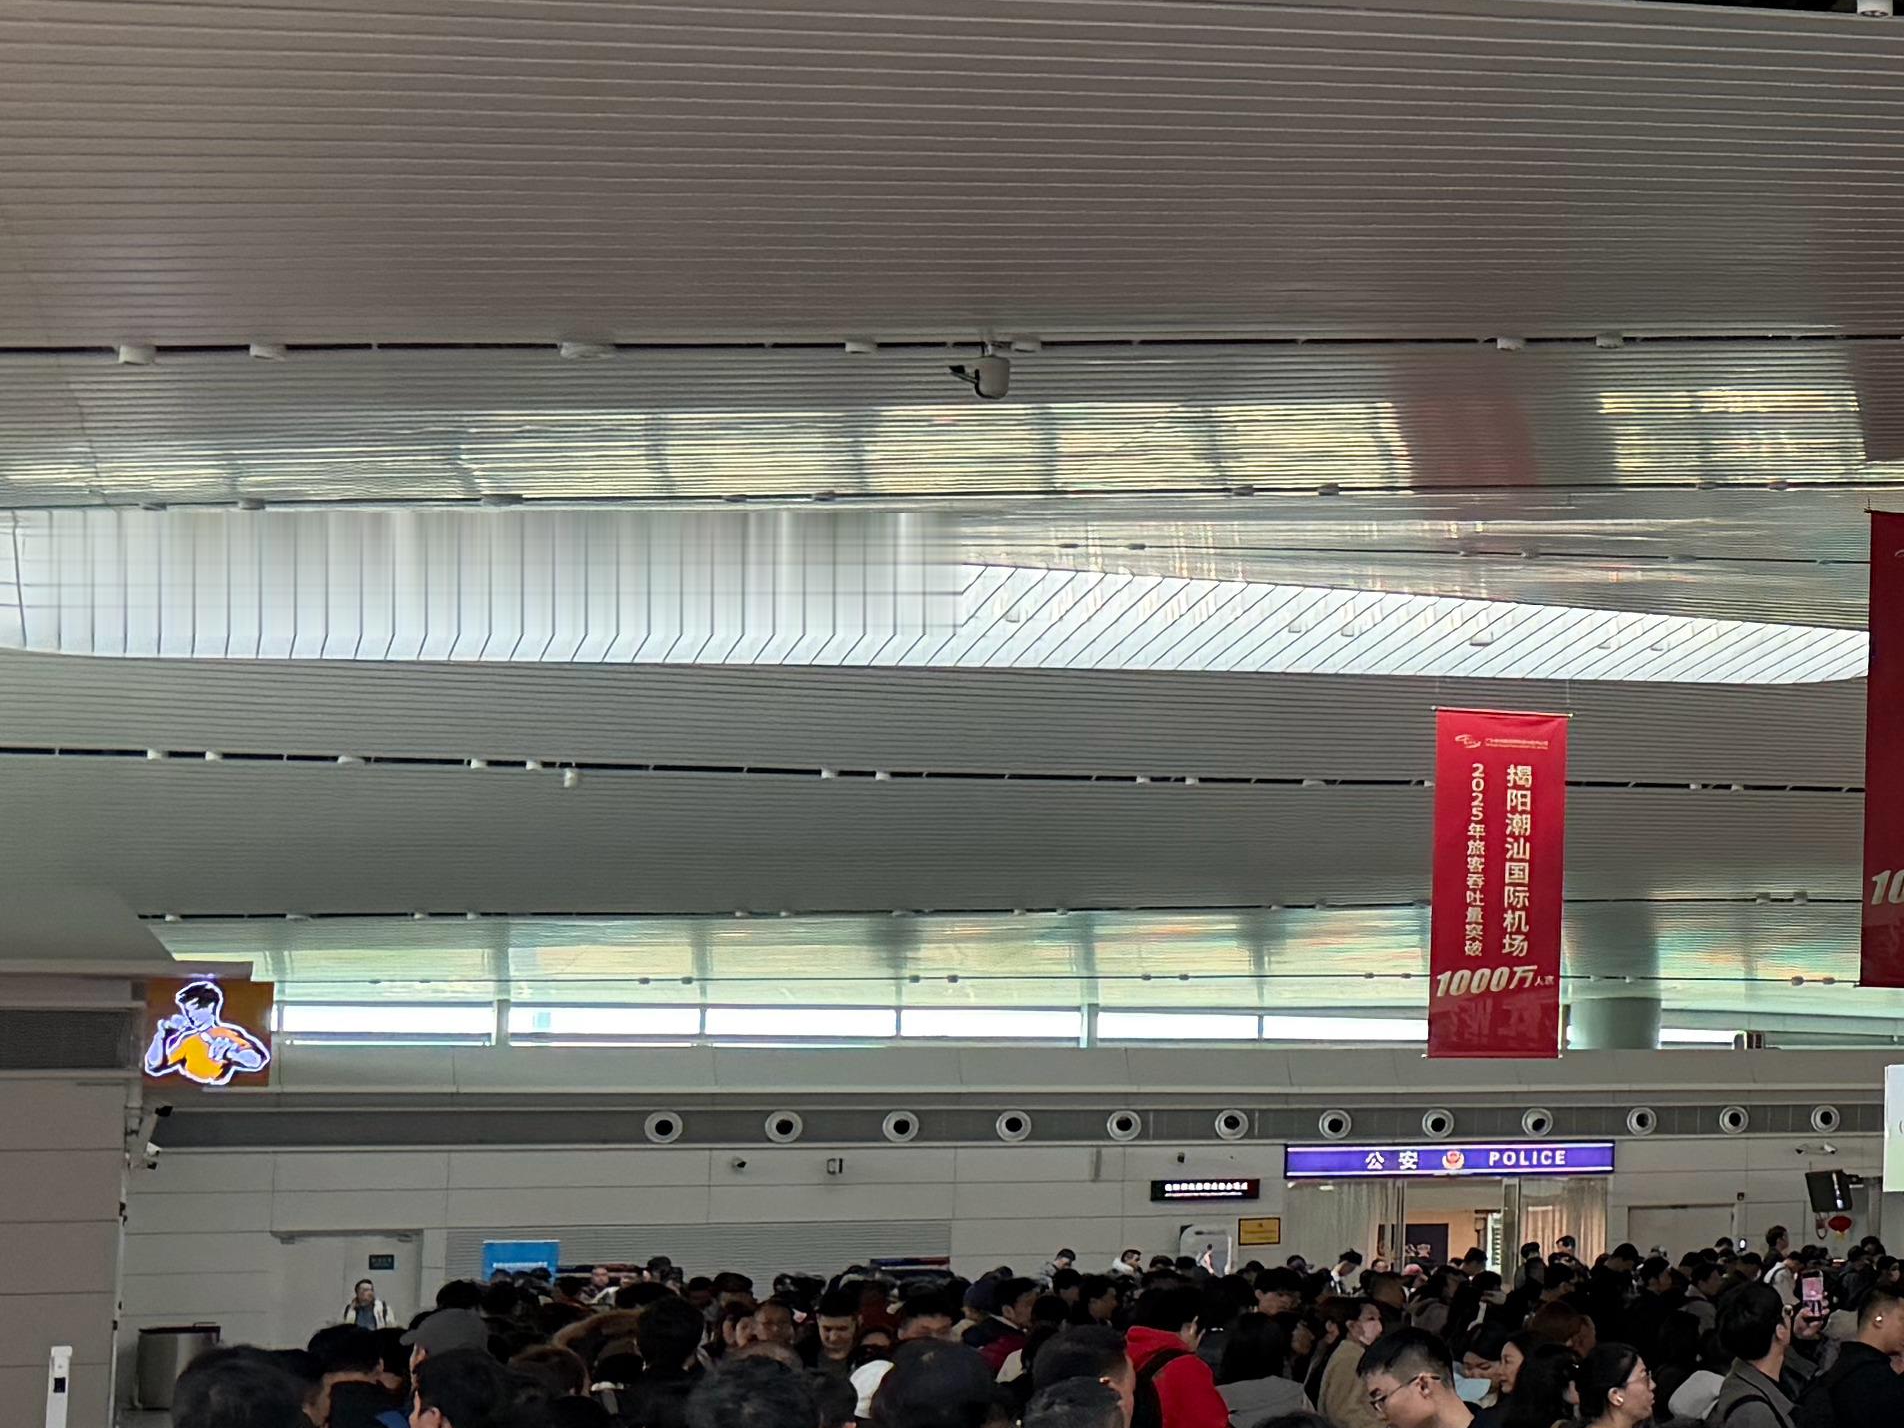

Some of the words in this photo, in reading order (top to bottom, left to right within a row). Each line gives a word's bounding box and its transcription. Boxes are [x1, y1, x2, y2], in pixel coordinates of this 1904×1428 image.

[1464, 762, 1486, 957] 2025年旅客吞吐量突破
[1502, 763, 1533, 958] 揭阳潮汕国际机场
[1365, 1150, 1420, 1172] 公安
[1488, 1149, 1567, 1167] POLICE
